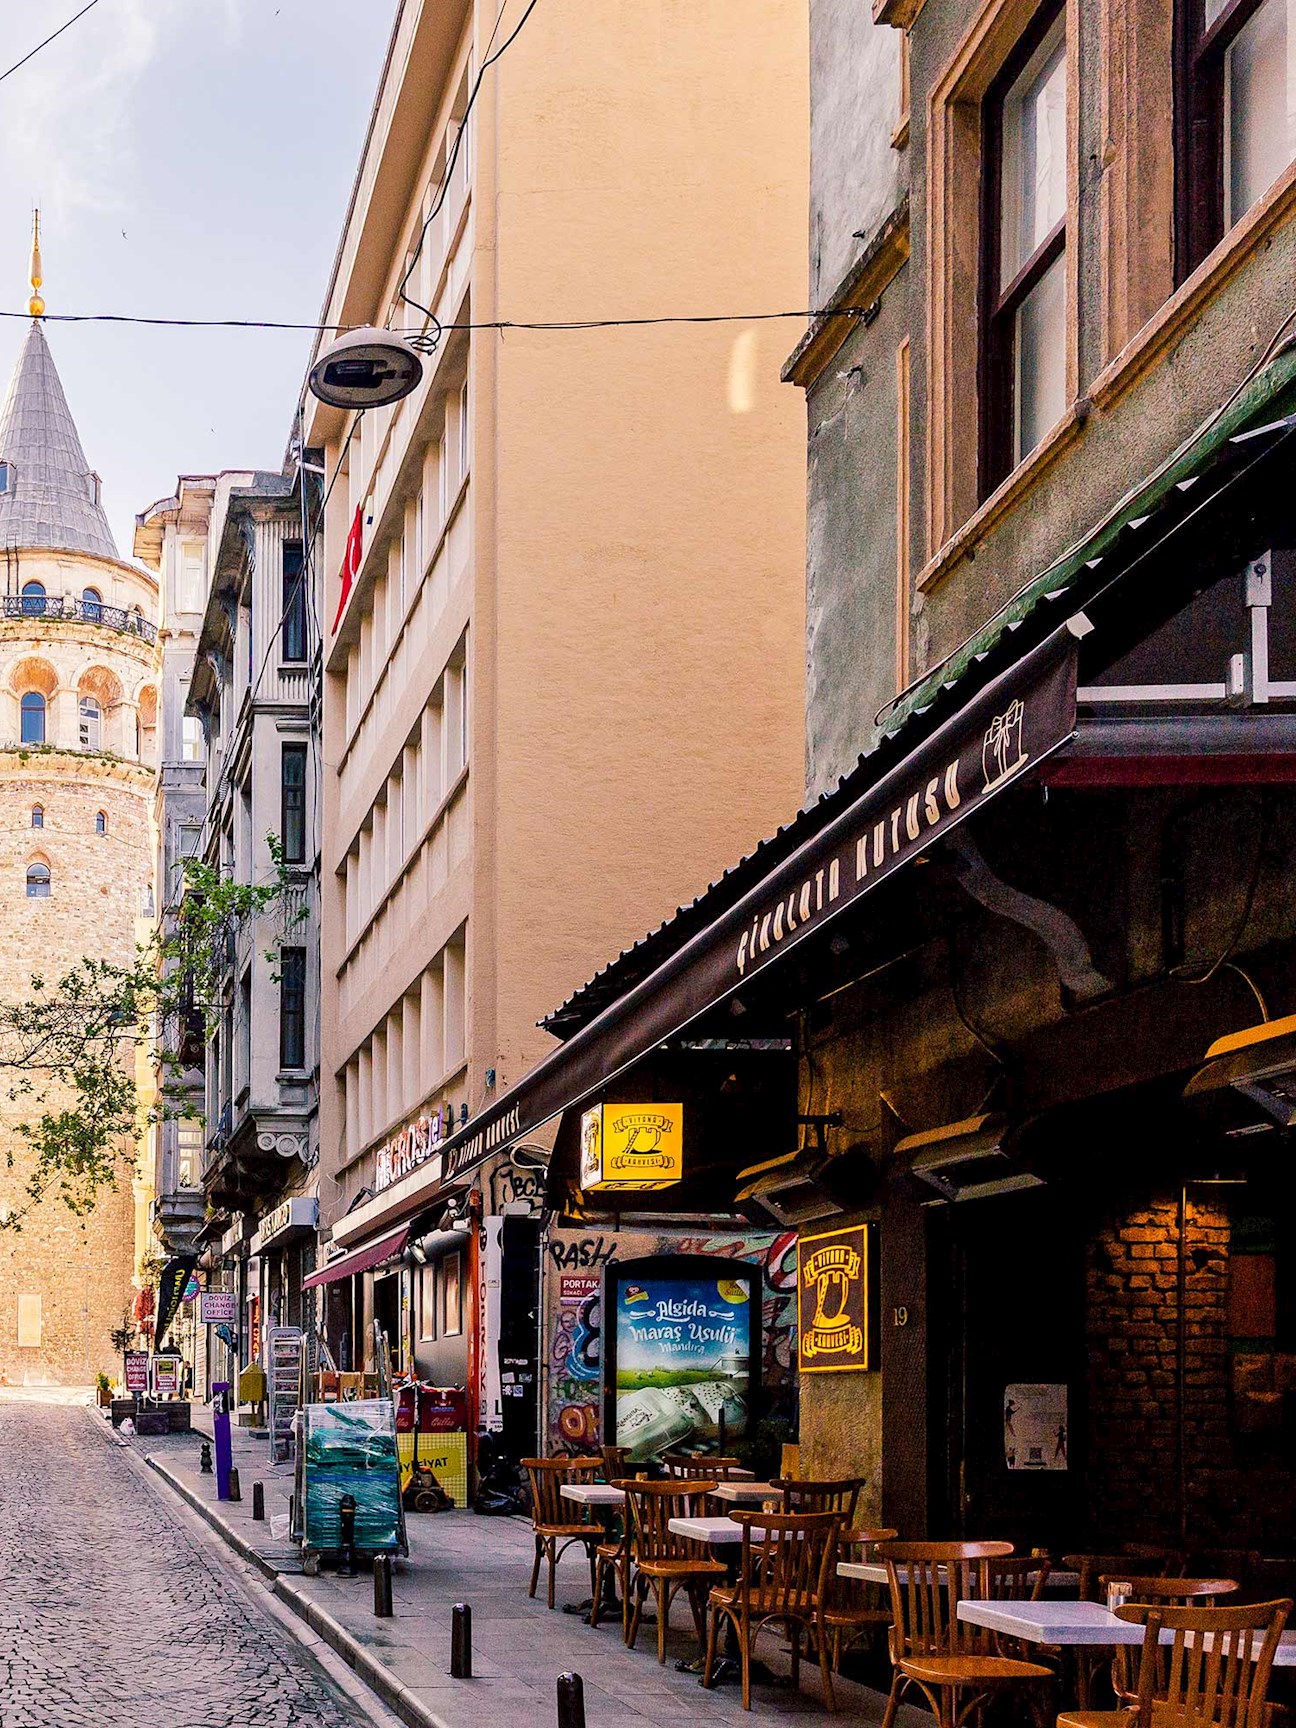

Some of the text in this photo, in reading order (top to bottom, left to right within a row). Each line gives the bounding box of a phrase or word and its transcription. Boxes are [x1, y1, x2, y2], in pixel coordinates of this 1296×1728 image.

[736, 758, 962, 976] ÇİKOLATA KUTUSU
[563, 1279, 601, 1288] PORTAK
[656, 1299, 707, 1323] Algida
[893, 1307, 908, 1326] 19
